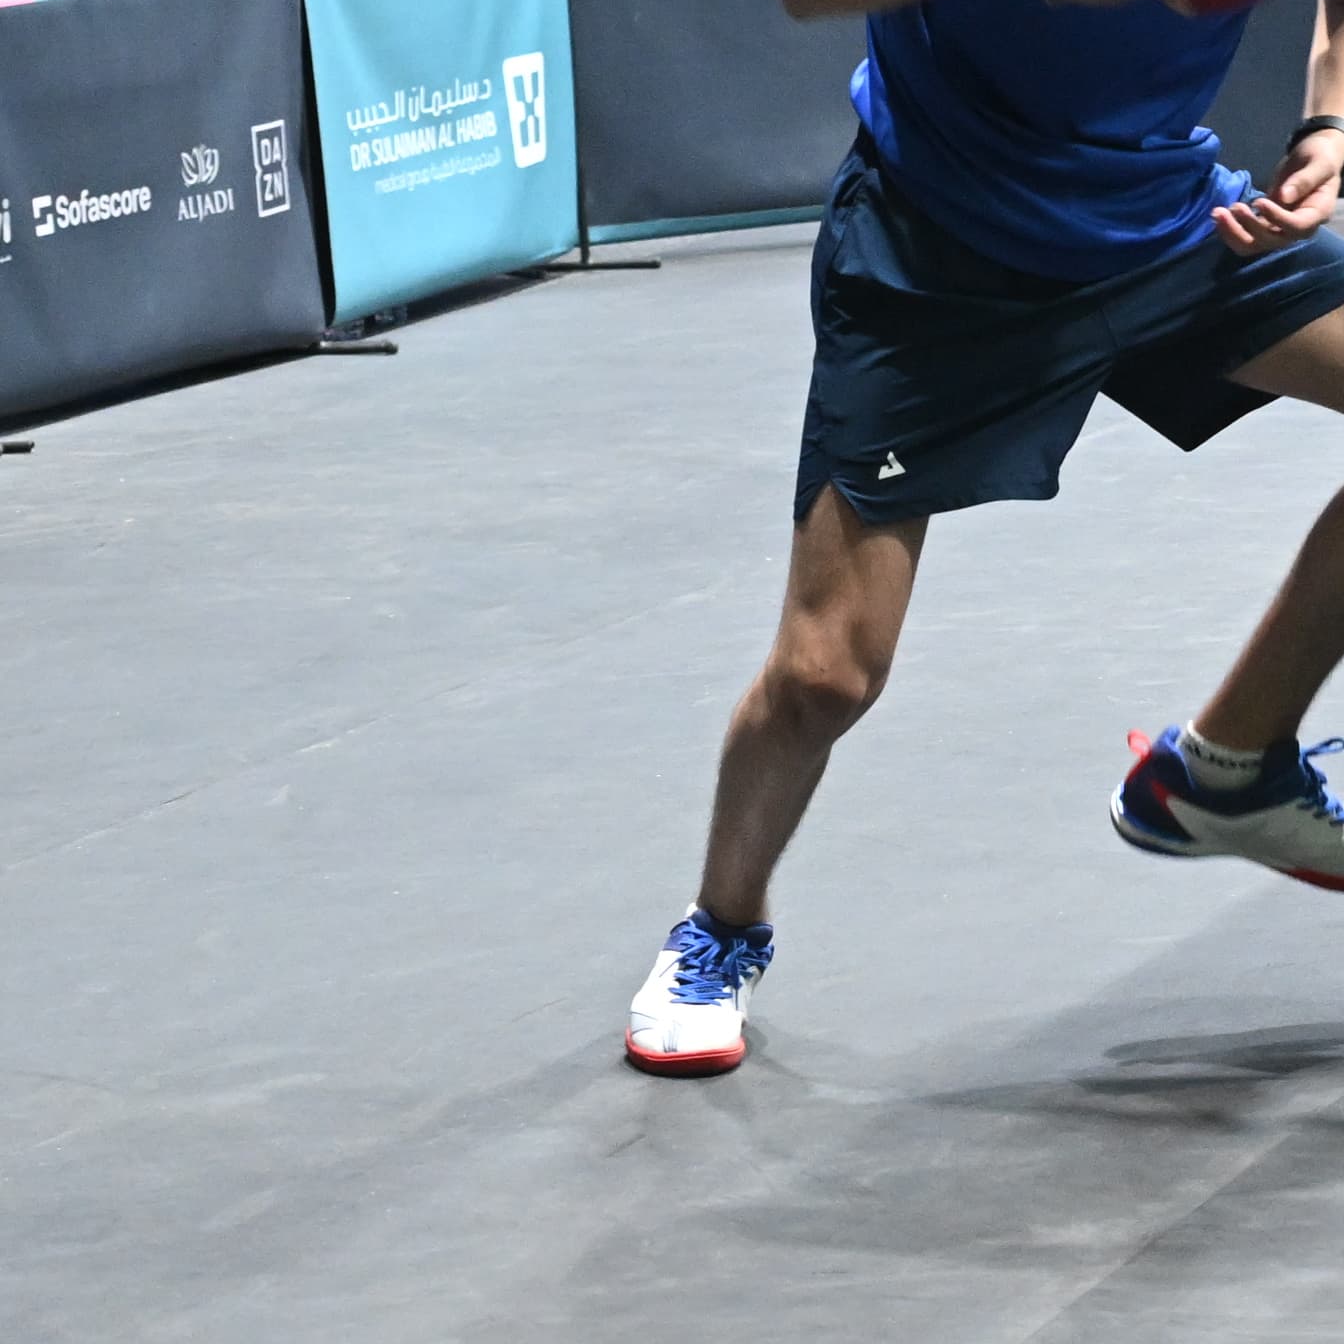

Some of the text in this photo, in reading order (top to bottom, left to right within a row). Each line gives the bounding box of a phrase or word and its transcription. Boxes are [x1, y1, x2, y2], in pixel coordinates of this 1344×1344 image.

[350, 111, 497, 171] DR SULAIMAN AL HABIB
[56, 186, 152, 229] Sofascore
